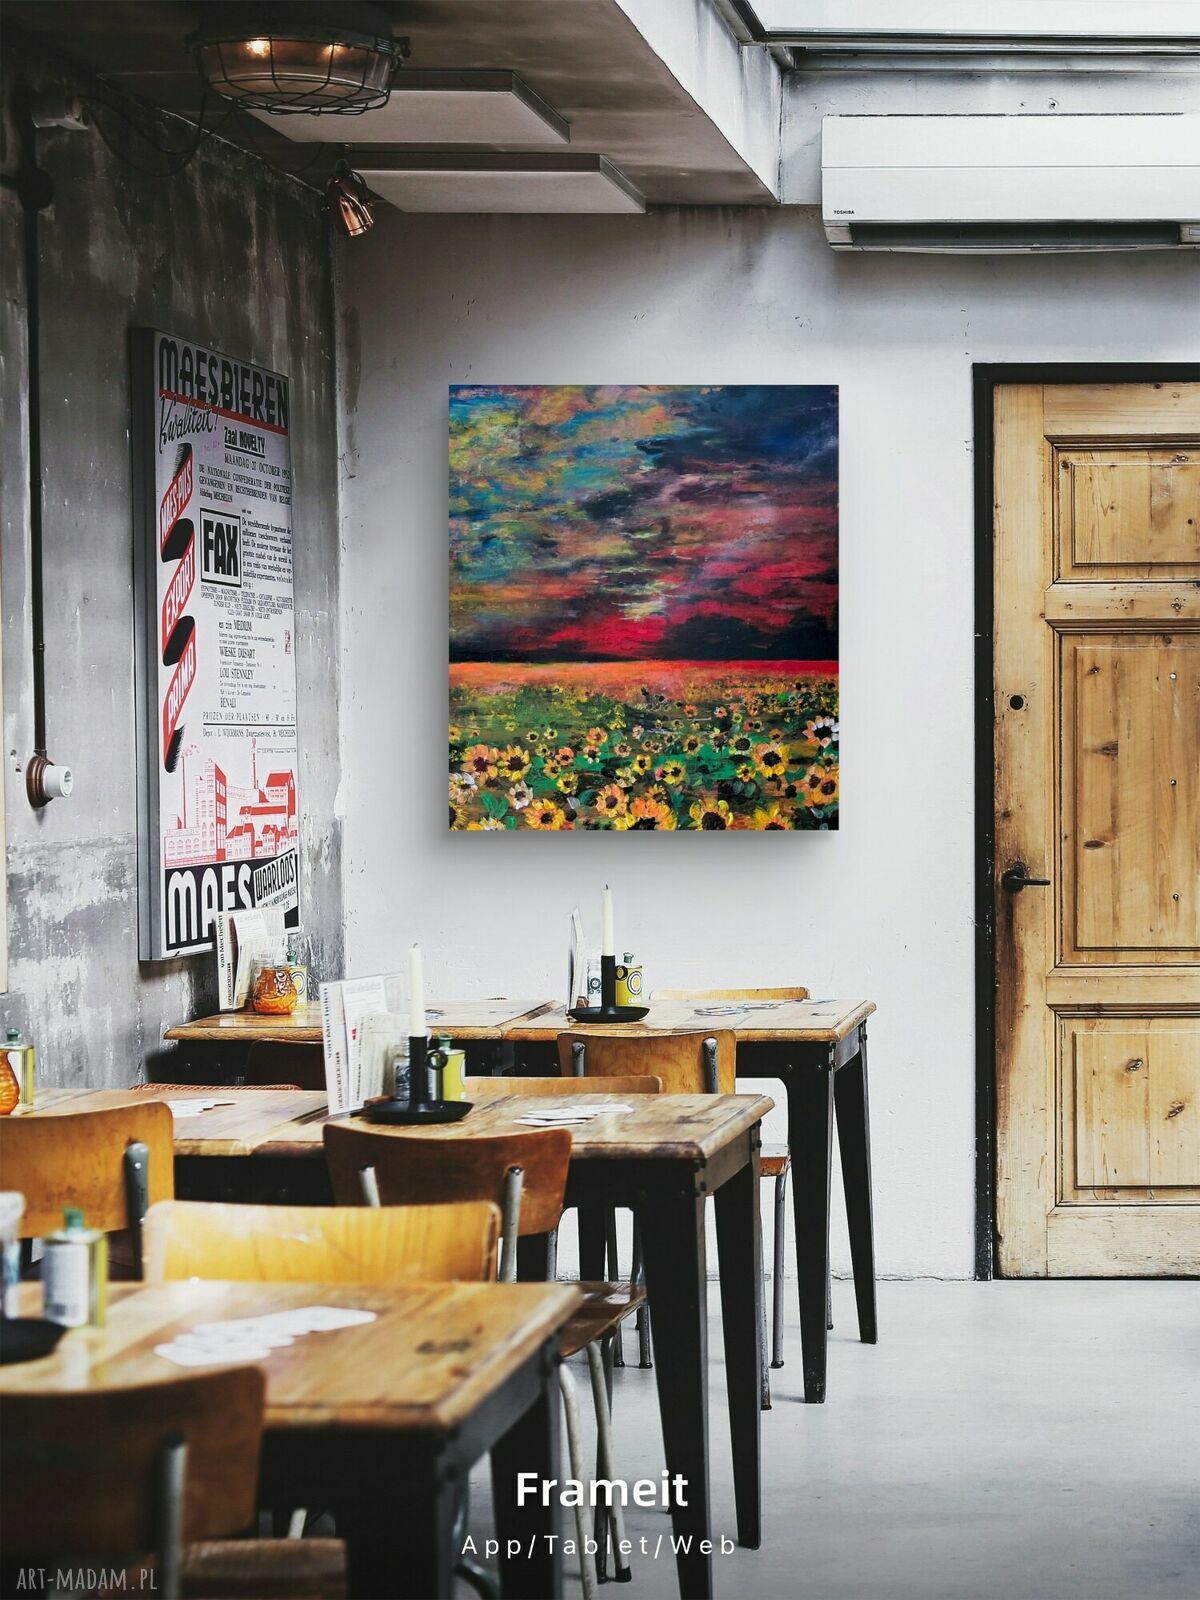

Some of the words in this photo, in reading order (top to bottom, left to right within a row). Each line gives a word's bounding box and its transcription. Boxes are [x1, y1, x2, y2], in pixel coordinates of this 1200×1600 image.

[159, 337, 287, 429] MAESBIEREN
[224, 426, 237, 447] Zaal
[239, 430, 265, 454] NOVELTY
[225, 453, 249, 470] MAANDAG
[259, 462, 280, 477] OCTOBER
[203, 519, 239, 577] FAX
[255, 853, 294, 902] WAARLOOS
